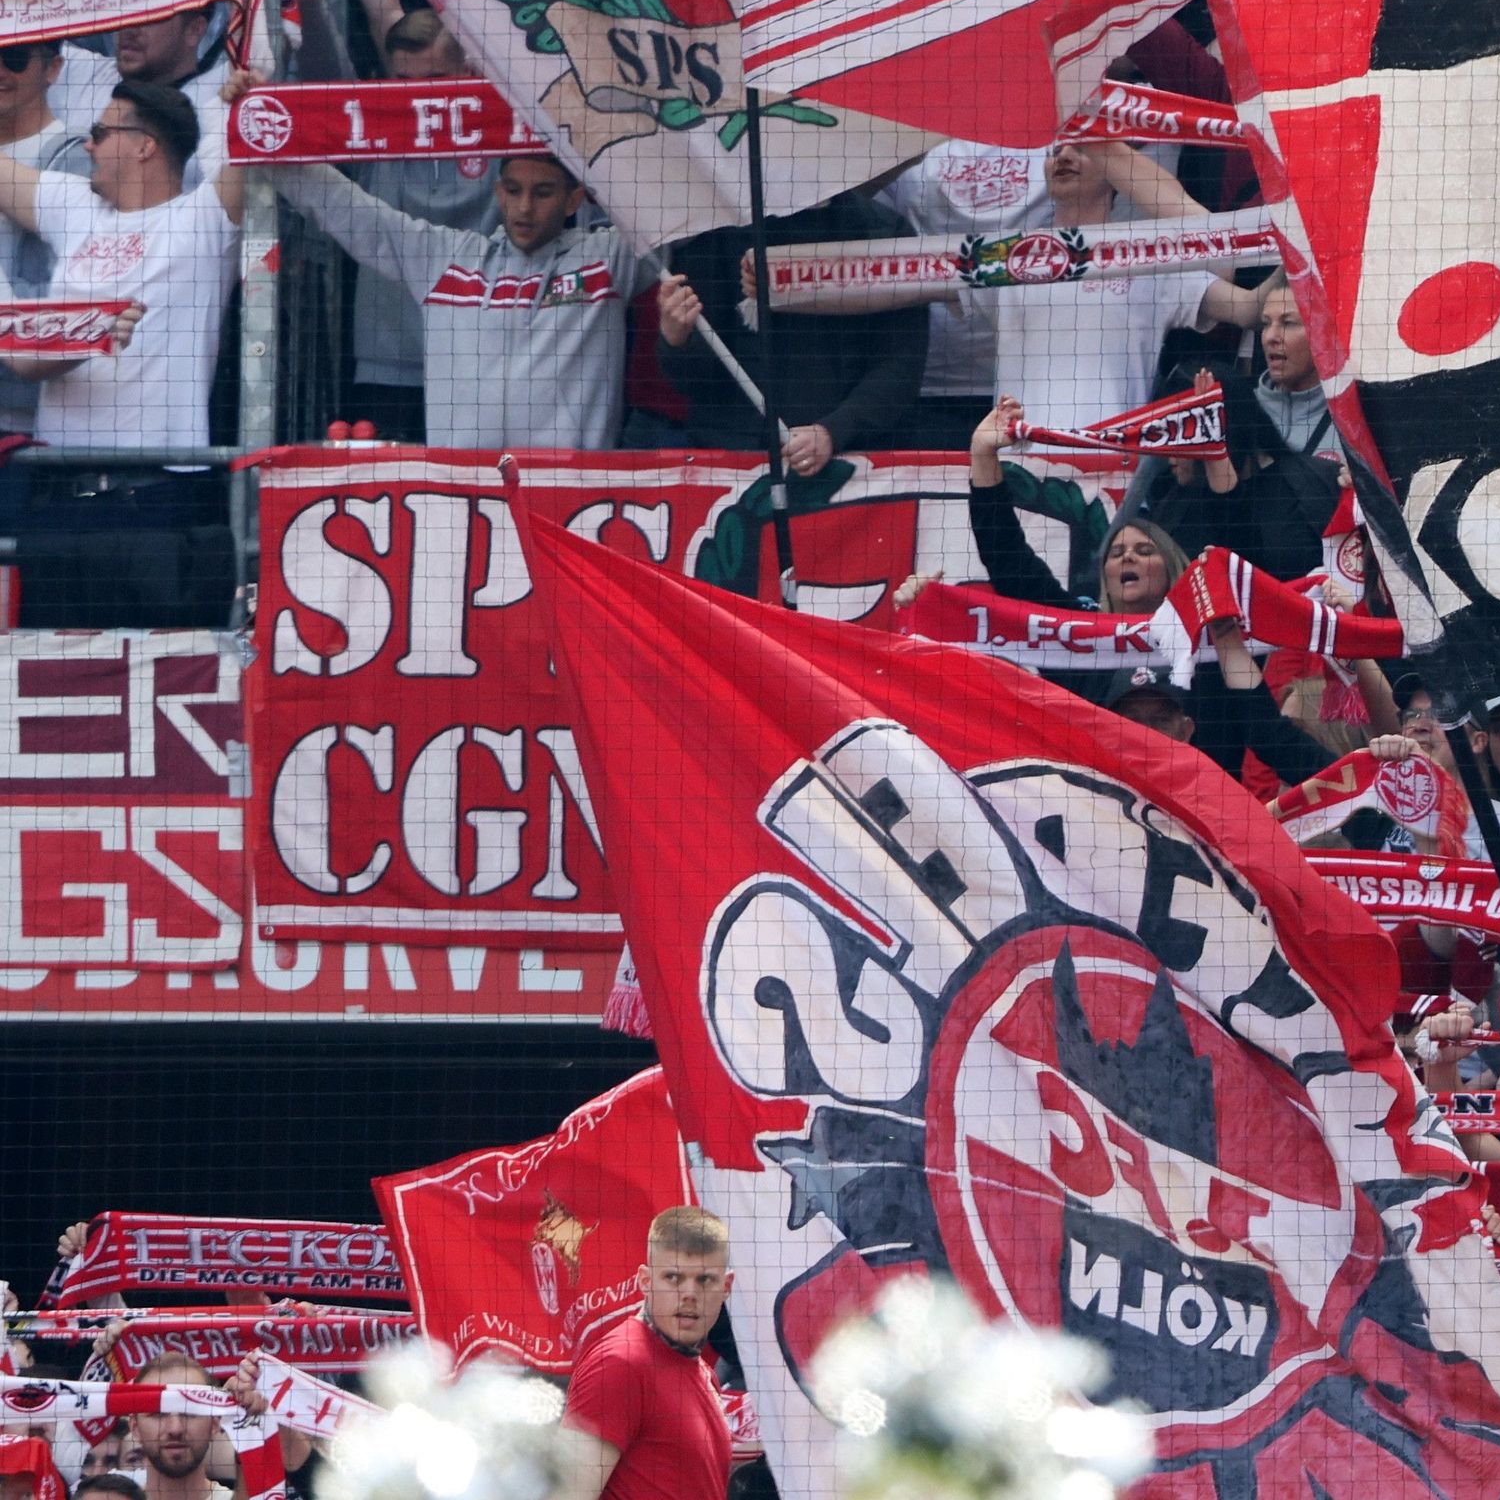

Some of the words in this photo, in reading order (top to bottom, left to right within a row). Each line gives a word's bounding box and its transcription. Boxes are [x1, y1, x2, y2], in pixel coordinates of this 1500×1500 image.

[606, 25, 725, 108] SPS
[344, 100, 387, 150] 1.
[414, 97, 483, 147] FC
[766, 252, 959, 293] UPPORTERS
[1092, 227, 1243, 269] COLOGNE
[967, 606, 1007, 648] 1.
[1027, 612, 1102, 656] FC
[271, 723, 609, 900] CGN
[125, 1228, 174, 1266] 1.
[184, 1228, 273, 1272] FC
[138, 1267, 186, 1284] DIE
[199, 1269, 298, 1288] MACHT
[311, 1273, 353, 1290] AM
